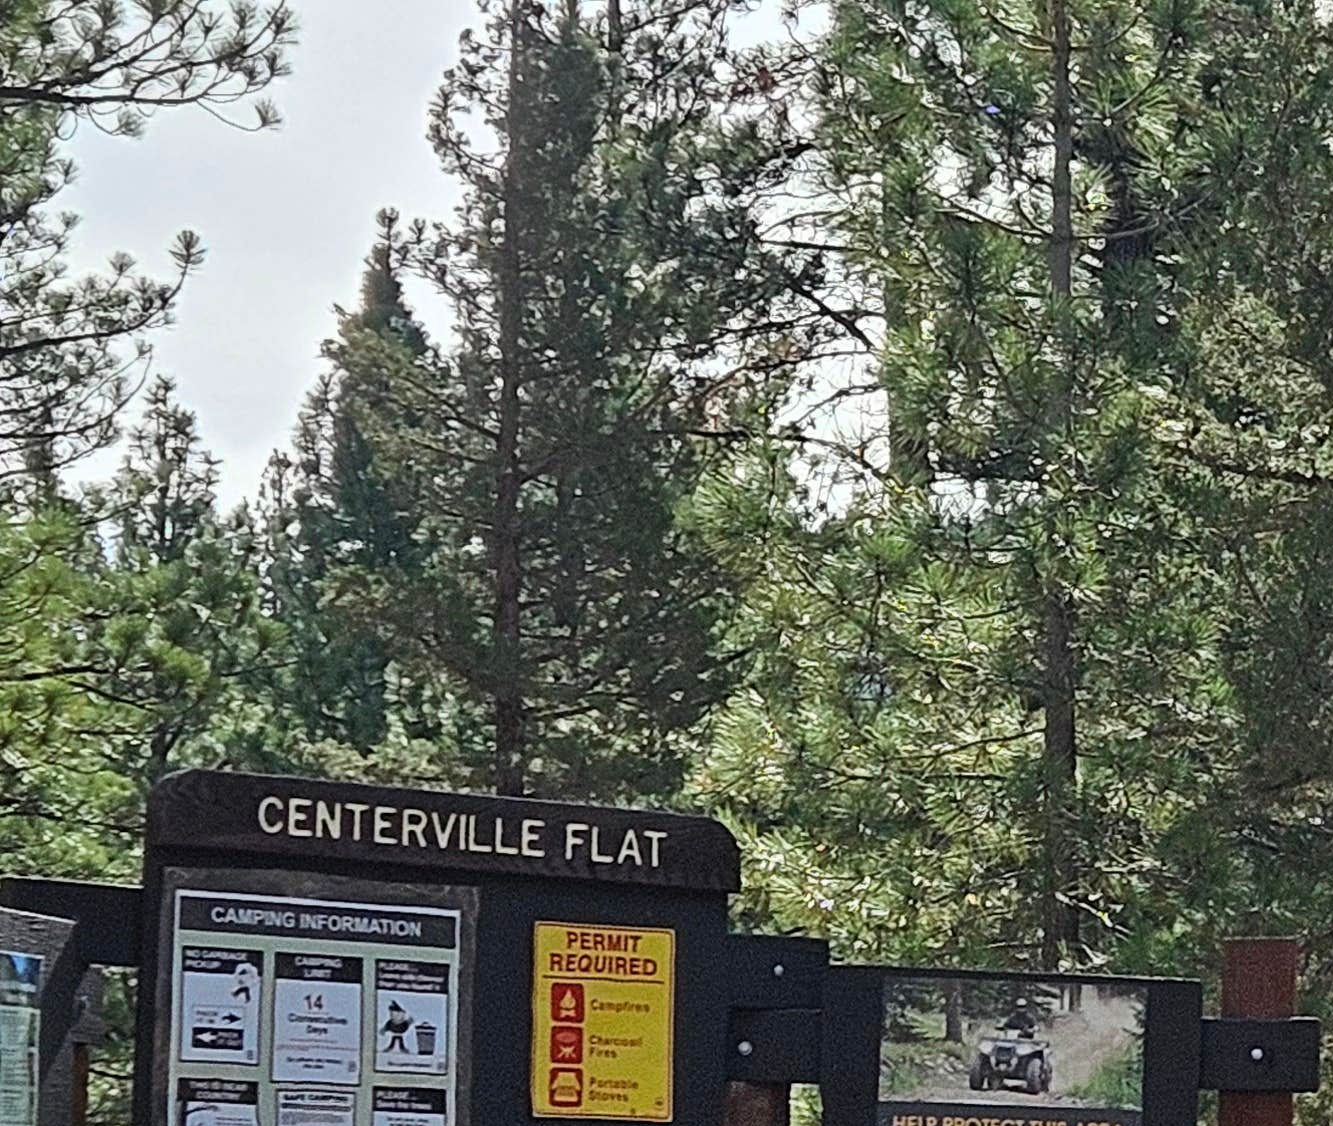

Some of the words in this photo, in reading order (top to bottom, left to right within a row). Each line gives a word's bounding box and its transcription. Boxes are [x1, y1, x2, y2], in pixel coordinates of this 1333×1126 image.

[257, 795, 546, 858] CENTERVILLE
[564, 822, 669, 868] FLAT
[210, 906, 295, 929] CAMPING
[299, 912, 422, 937] INFORMATION
[566, 931, 643, 953] PERMIT
[549, 953, 658, 976] REQUIRED
[303, 993, 324, 1011] 14
[589, 998, 651, 1014] Campfires
[588, 1034, 644, 1047] Charcoal
[588, 1047, 618, 1059] Fires
[588, 1076, 640, 1090] Portable
[588, 1088, 630, 1103] Stoves
